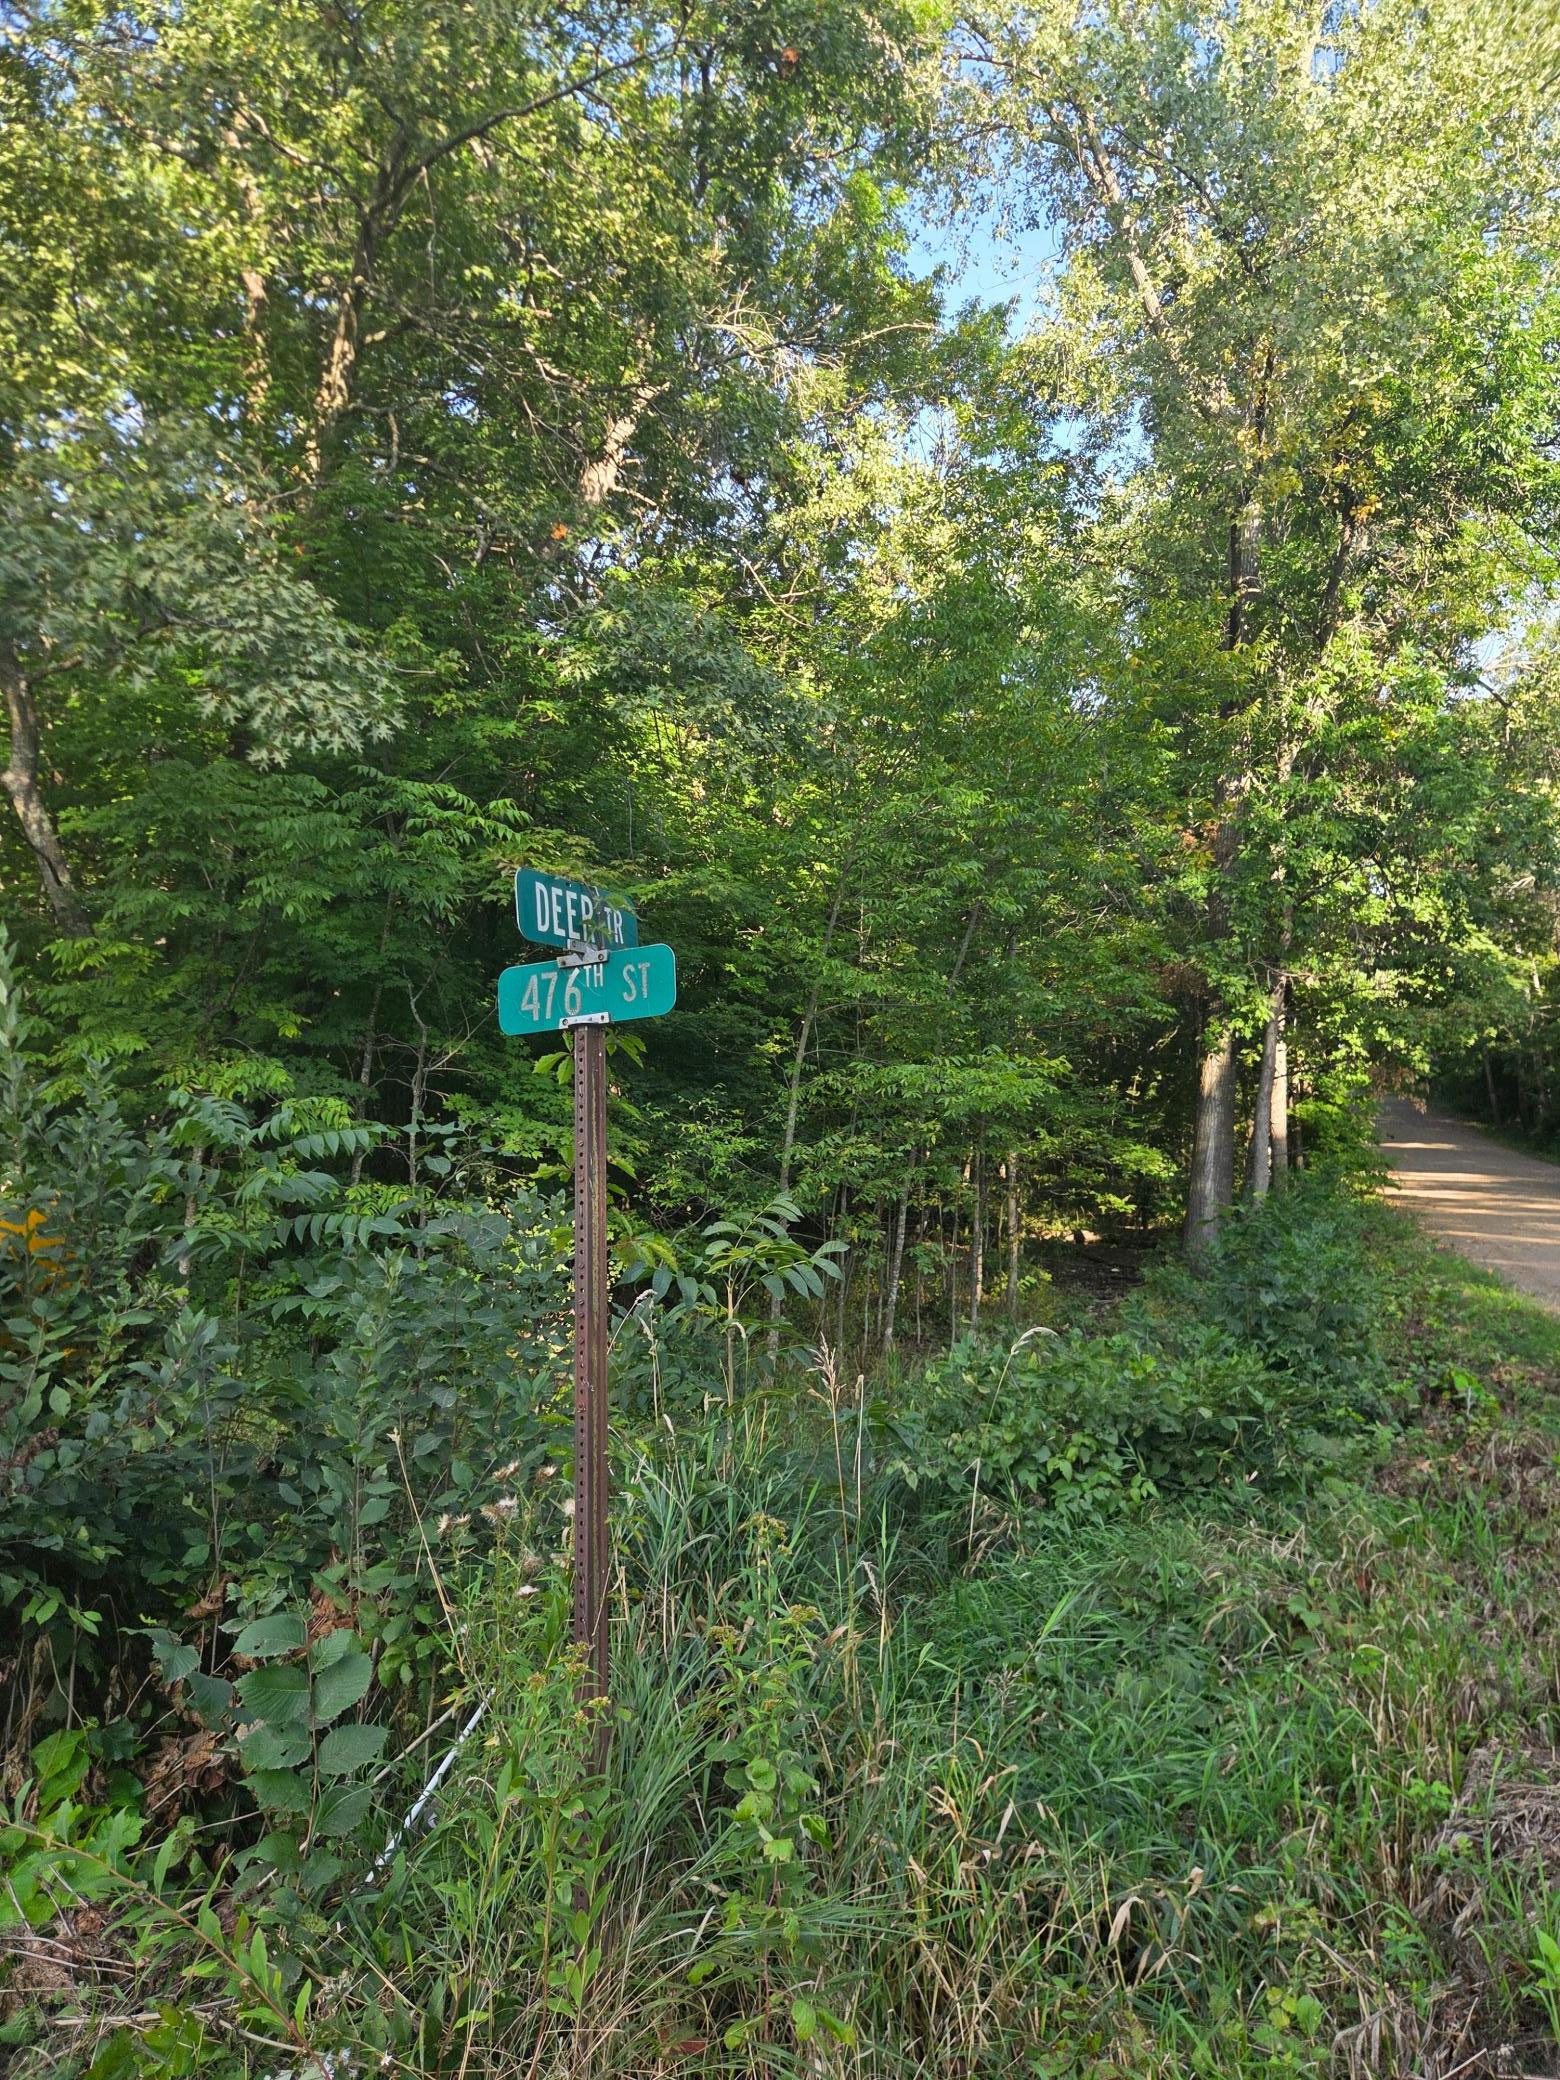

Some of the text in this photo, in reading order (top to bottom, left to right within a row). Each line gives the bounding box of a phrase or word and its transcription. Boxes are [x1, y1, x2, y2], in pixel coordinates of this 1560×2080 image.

[535, 881, 624, 945] DEER TR
[521, 962, 651, 1022] 476TH ST
